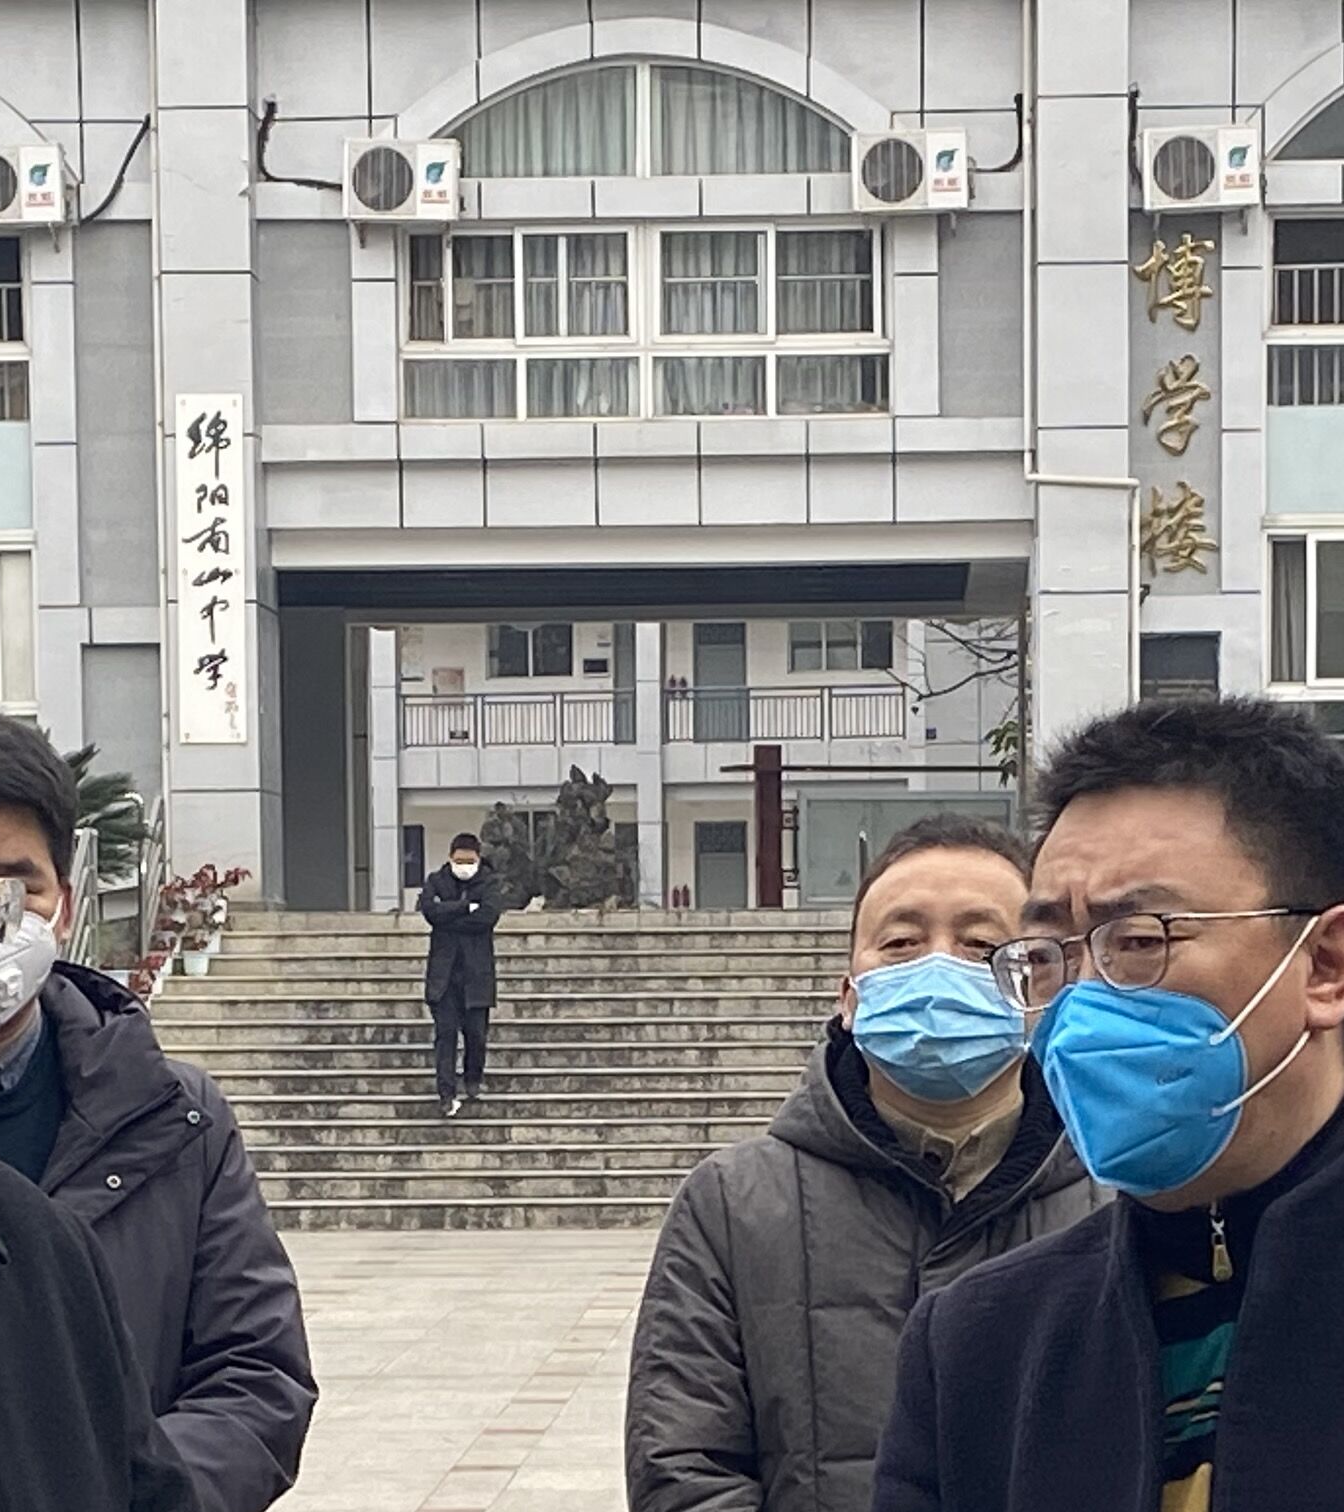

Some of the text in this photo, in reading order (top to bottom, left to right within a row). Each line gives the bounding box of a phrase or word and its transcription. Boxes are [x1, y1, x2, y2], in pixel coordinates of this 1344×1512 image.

[182, 410, 233, 690] 绵阳南山中学
[1133, 234, 1219, 577] 博学楼
